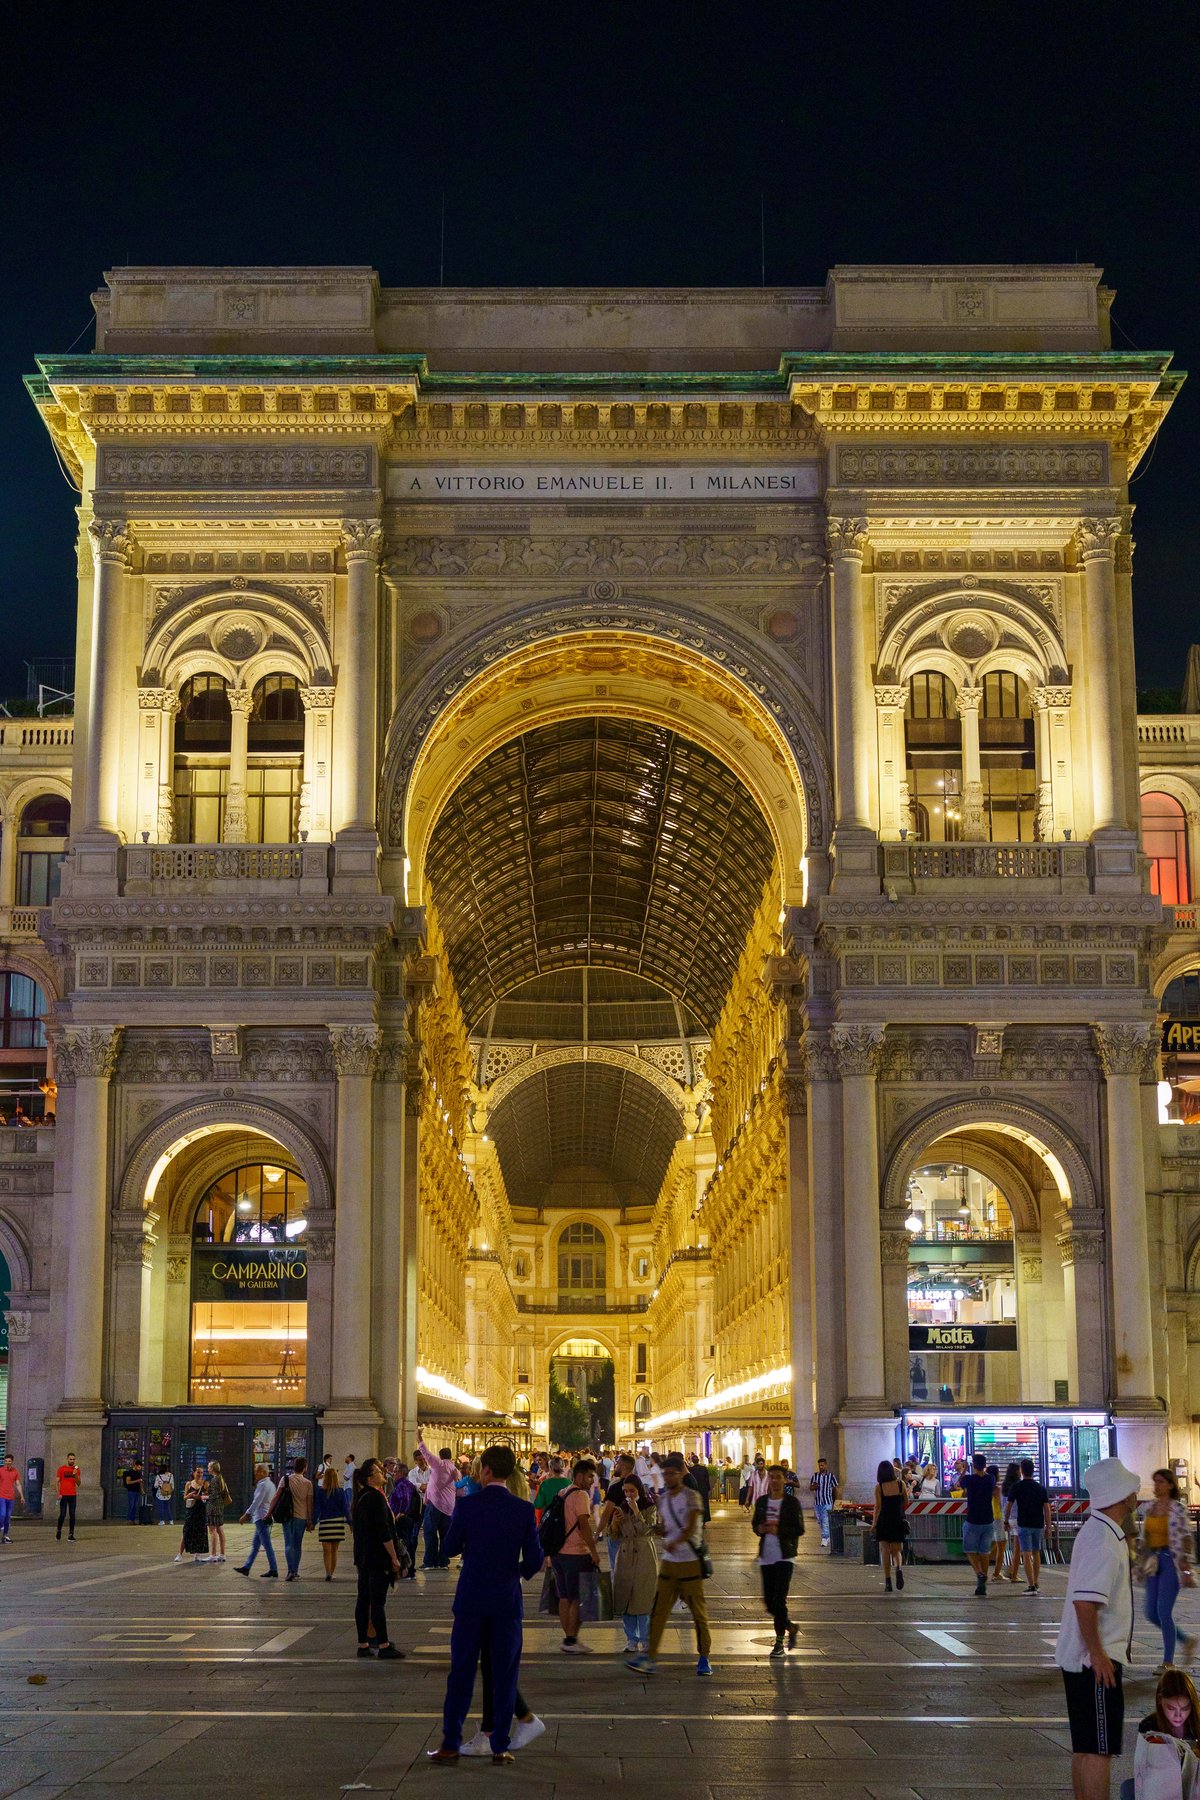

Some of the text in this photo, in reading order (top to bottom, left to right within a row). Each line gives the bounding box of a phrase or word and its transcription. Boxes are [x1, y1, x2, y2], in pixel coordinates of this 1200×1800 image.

[410, 476, 796, 490] A VITTORIO EMANUELE II. I MILANESI
[212, 1262, 307, 1279] CAMPARINO
[239, 1281, 278, 1289] IN GALLERIA
[924, 1290, 952, 1300] KING
[927, 1328, 975, 1344] Motta
[761, 1402, 789, 1411] Motta
